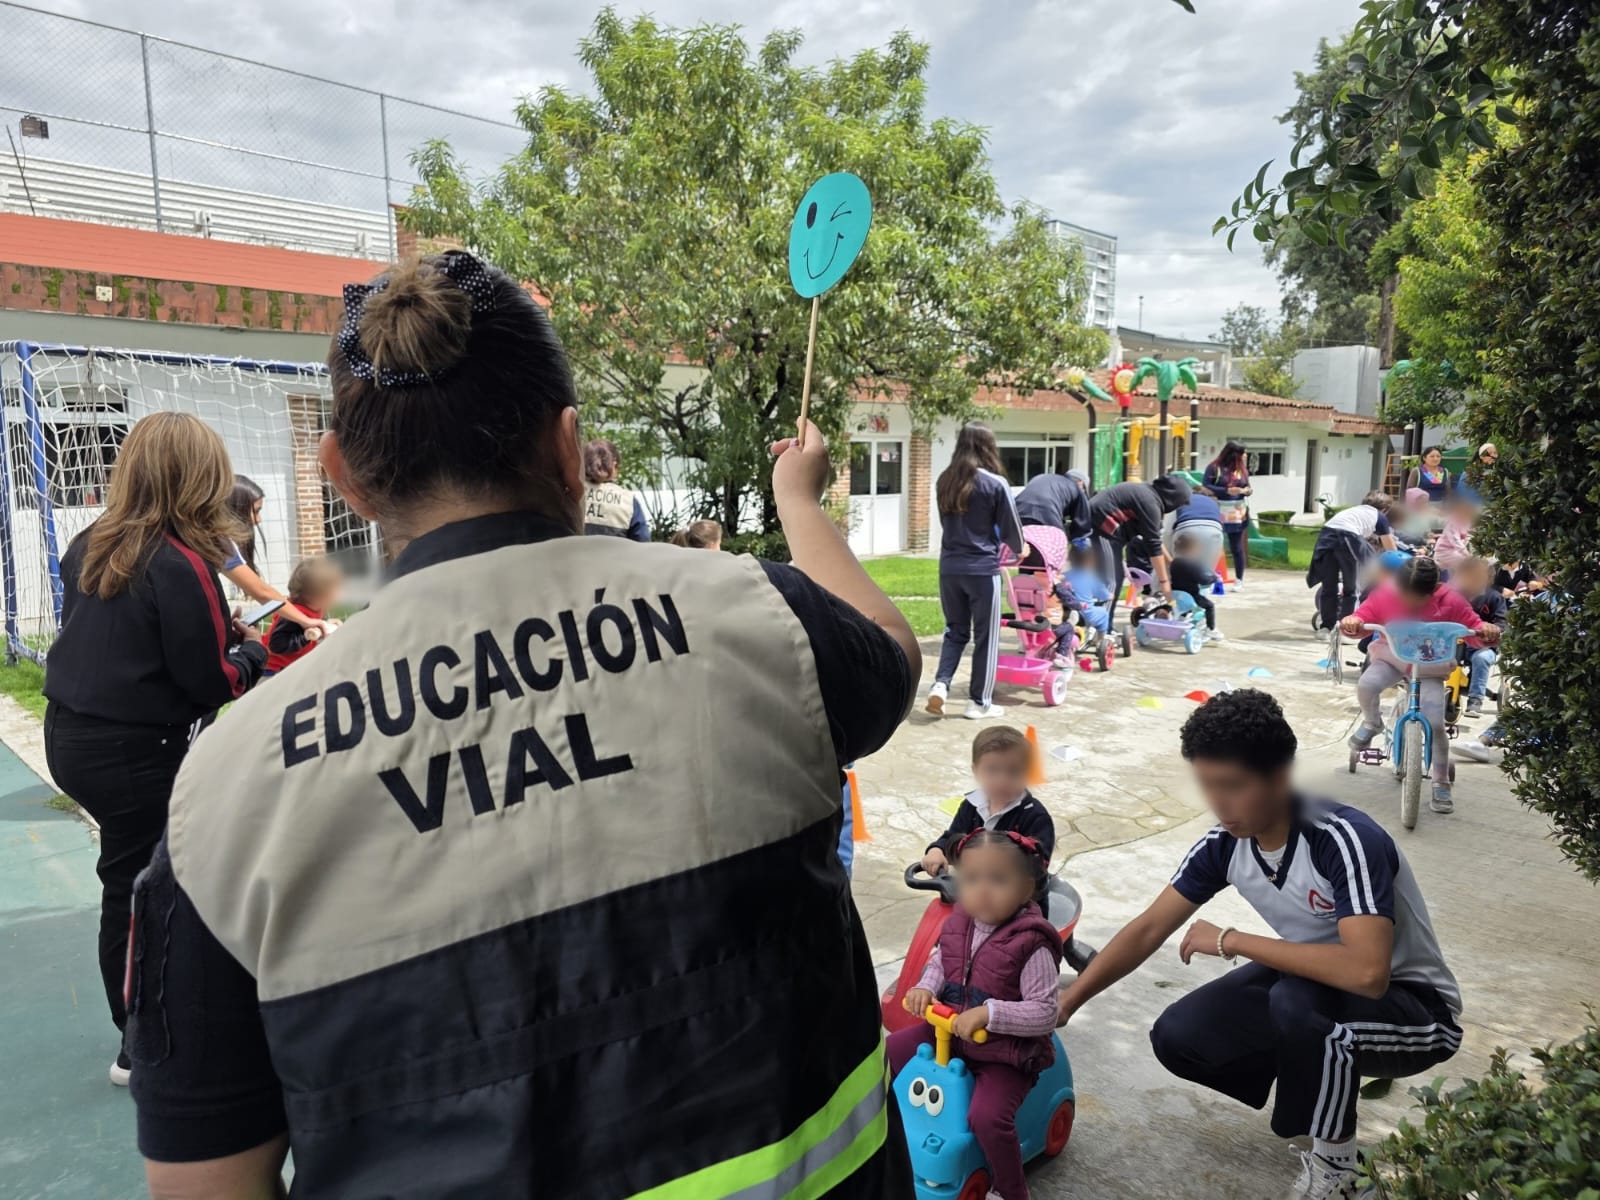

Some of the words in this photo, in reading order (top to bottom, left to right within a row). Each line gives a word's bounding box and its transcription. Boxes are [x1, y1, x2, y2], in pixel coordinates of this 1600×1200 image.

[586, 503, 604, 518] AL
[587, 487, 622, 504] ACIÓN
[282, 587, 690, 768] EDUCACIÓN
[378, 713, 634, 833] VIAL
